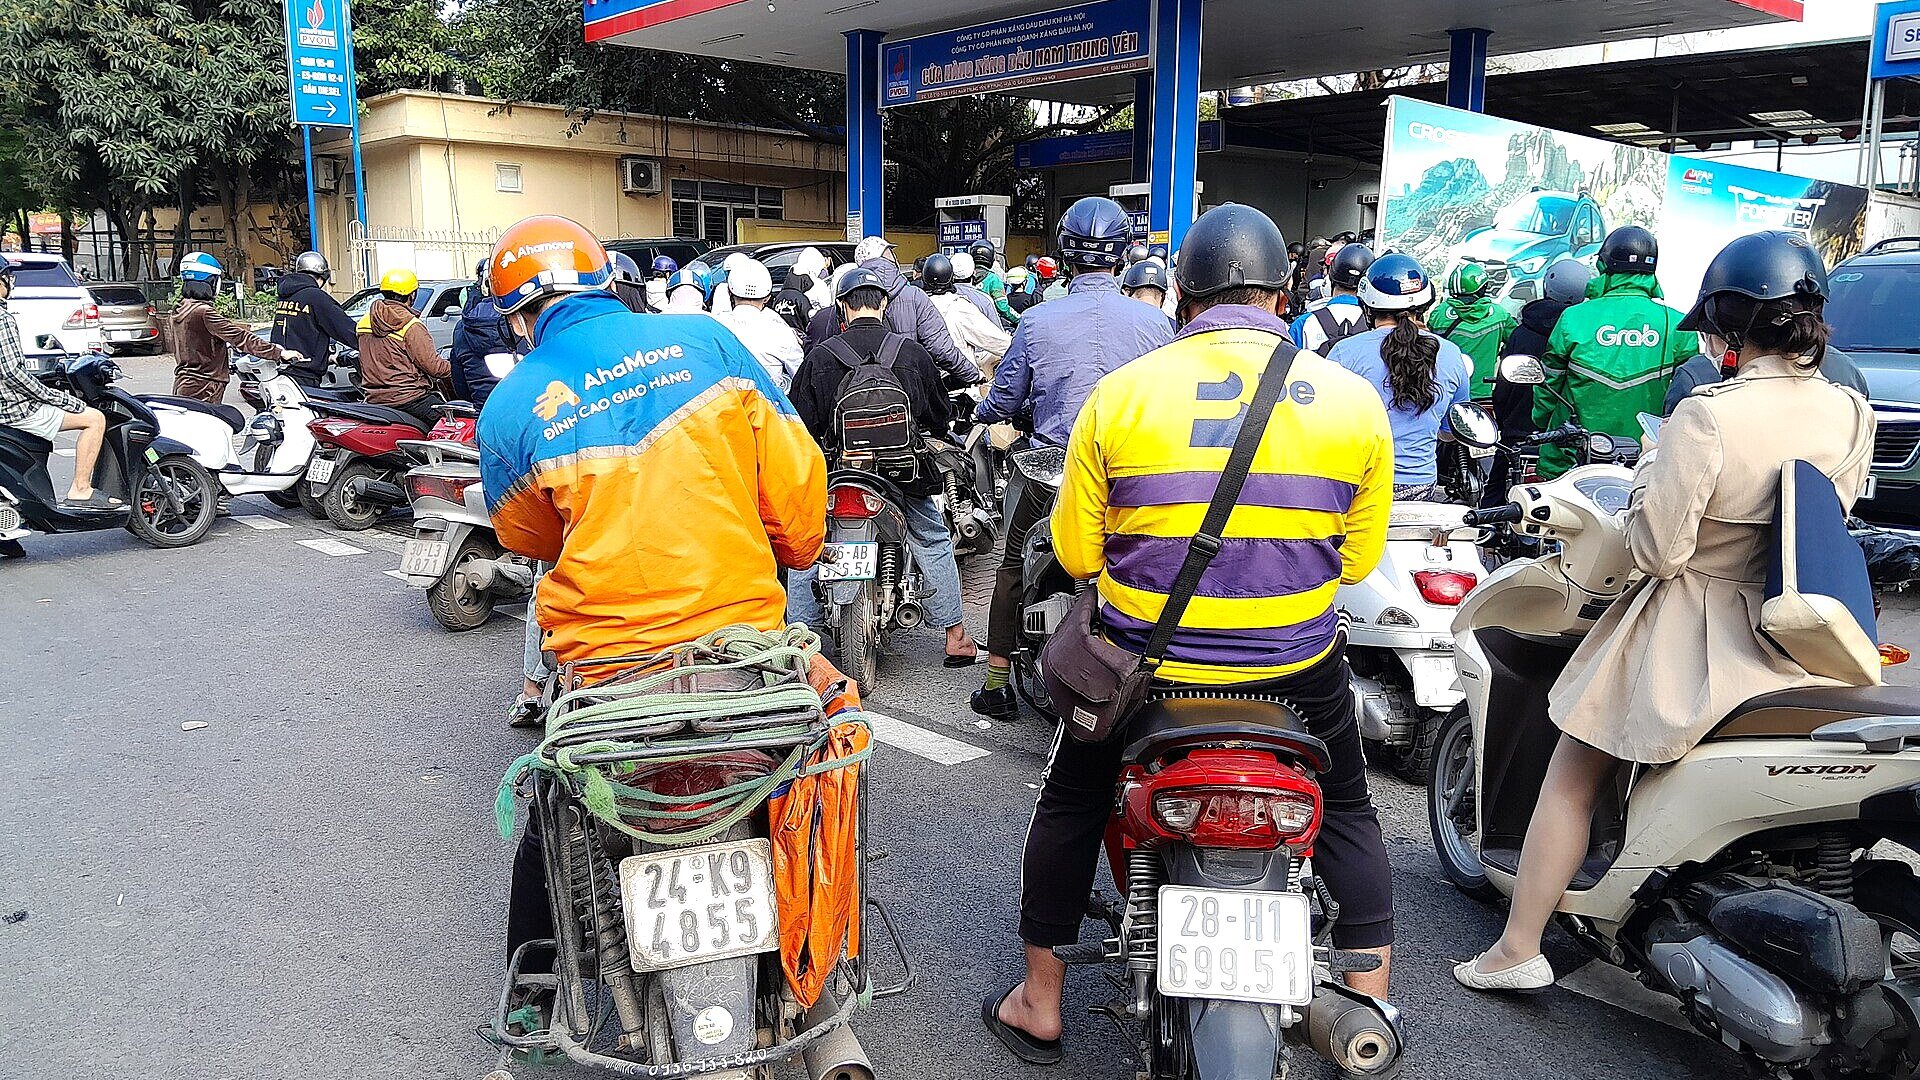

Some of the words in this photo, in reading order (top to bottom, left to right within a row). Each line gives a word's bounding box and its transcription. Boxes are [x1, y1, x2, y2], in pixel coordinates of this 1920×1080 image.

[302, 35, 333, 46] PVOIL
[943, 60, 974, 82] HÀNG
[974, 55, 1006, 77] XĂNG
[1007, 45, 1033, 72] DẦU
[1034, 45, 1065, 68] NAM
[1067, 37, 1109, 62] TRUNG
[1111, 30, 1139, 55] YÊN
[944, 225, 960, 235] XĂNG
[964, 223, 983, 234] XĂNG
[1596, 324, 1660, 347] Grab
[584, 344, 684, 391] AhaMove
[578, 397, 612, 419] CAO
[611, 383, 648, 405] GIAO
[648, 368, 693, 391] HÀNG
[832, 545, 868, 560] 6-AB
[1765, 764, 1877, 776] VISION
[652, 897, 758, 959] 4855
[1181, 895, 1281, 944] 28-H1
[1169, 944, 1296, 996] 699.51
